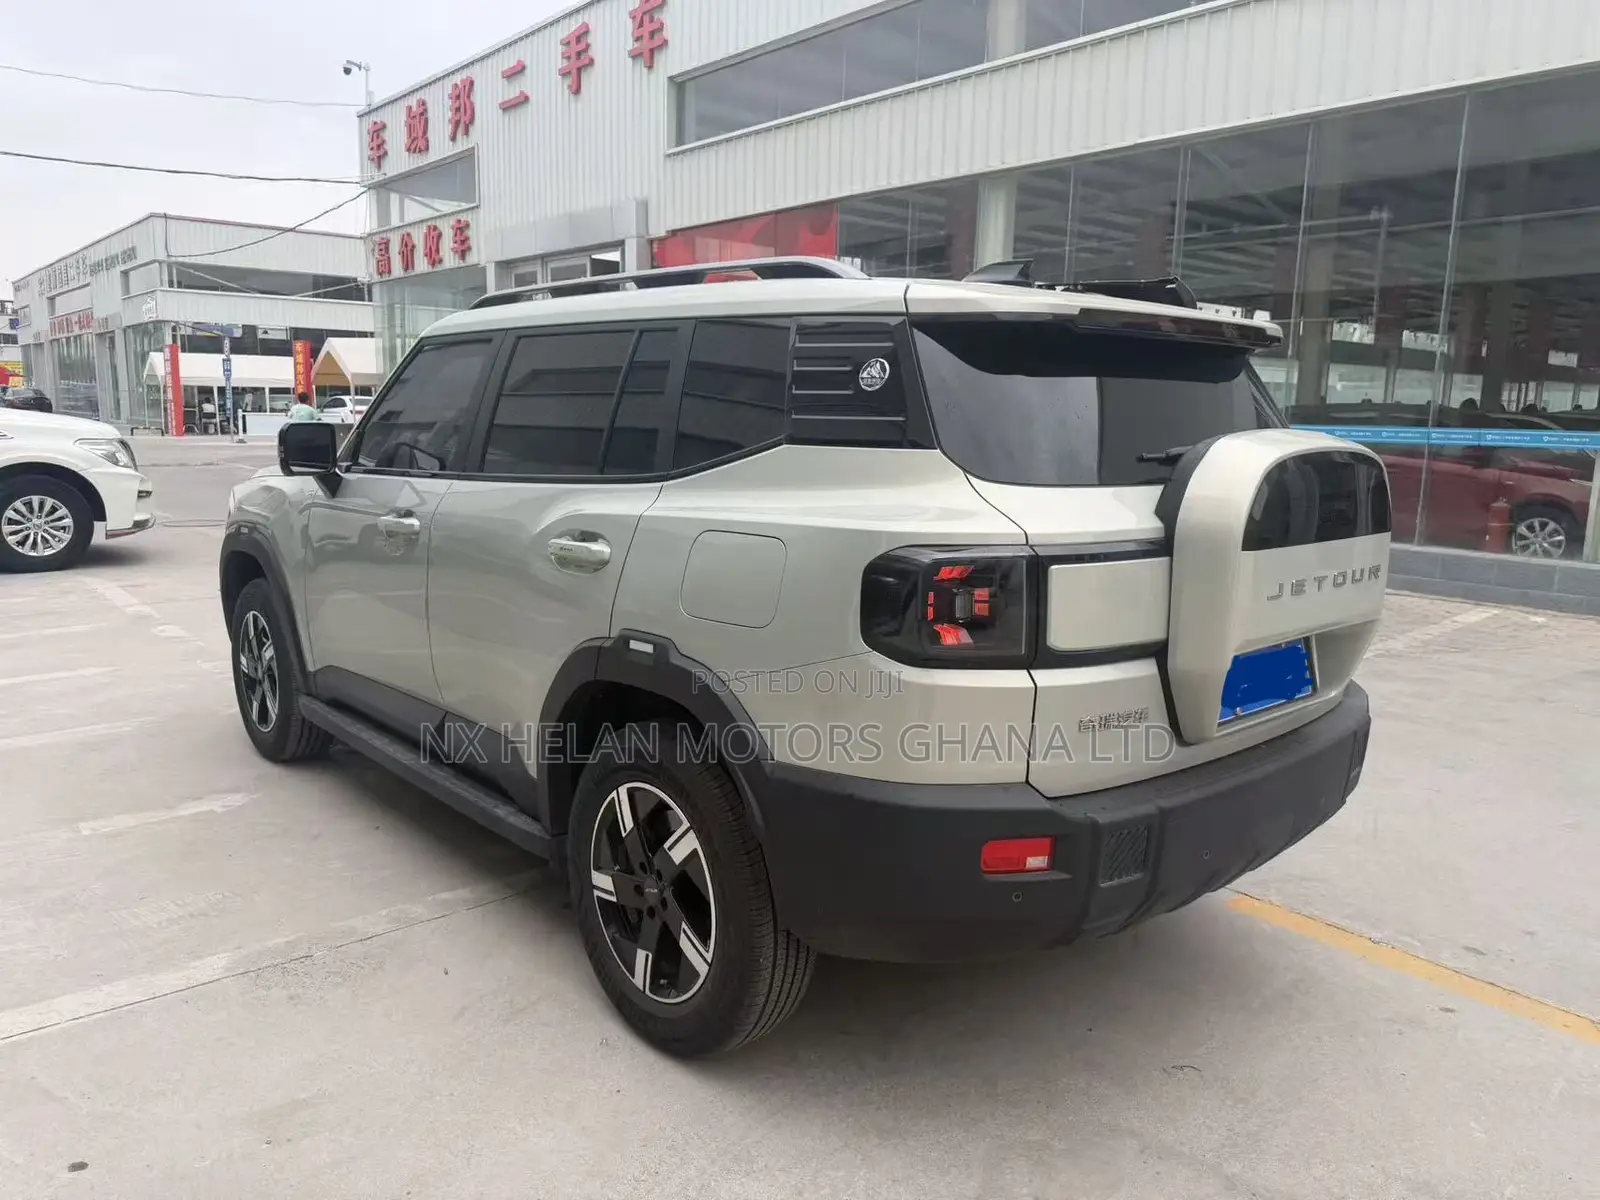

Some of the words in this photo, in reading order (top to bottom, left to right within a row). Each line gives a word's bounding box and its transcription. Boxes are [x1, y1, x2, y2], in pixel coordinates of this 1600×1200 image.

[367, 0, 669, 170] 车城邦二手车
[375, 218, 473, 279] 高价收车
[1266, 564, 1381, 601] JETOUR
